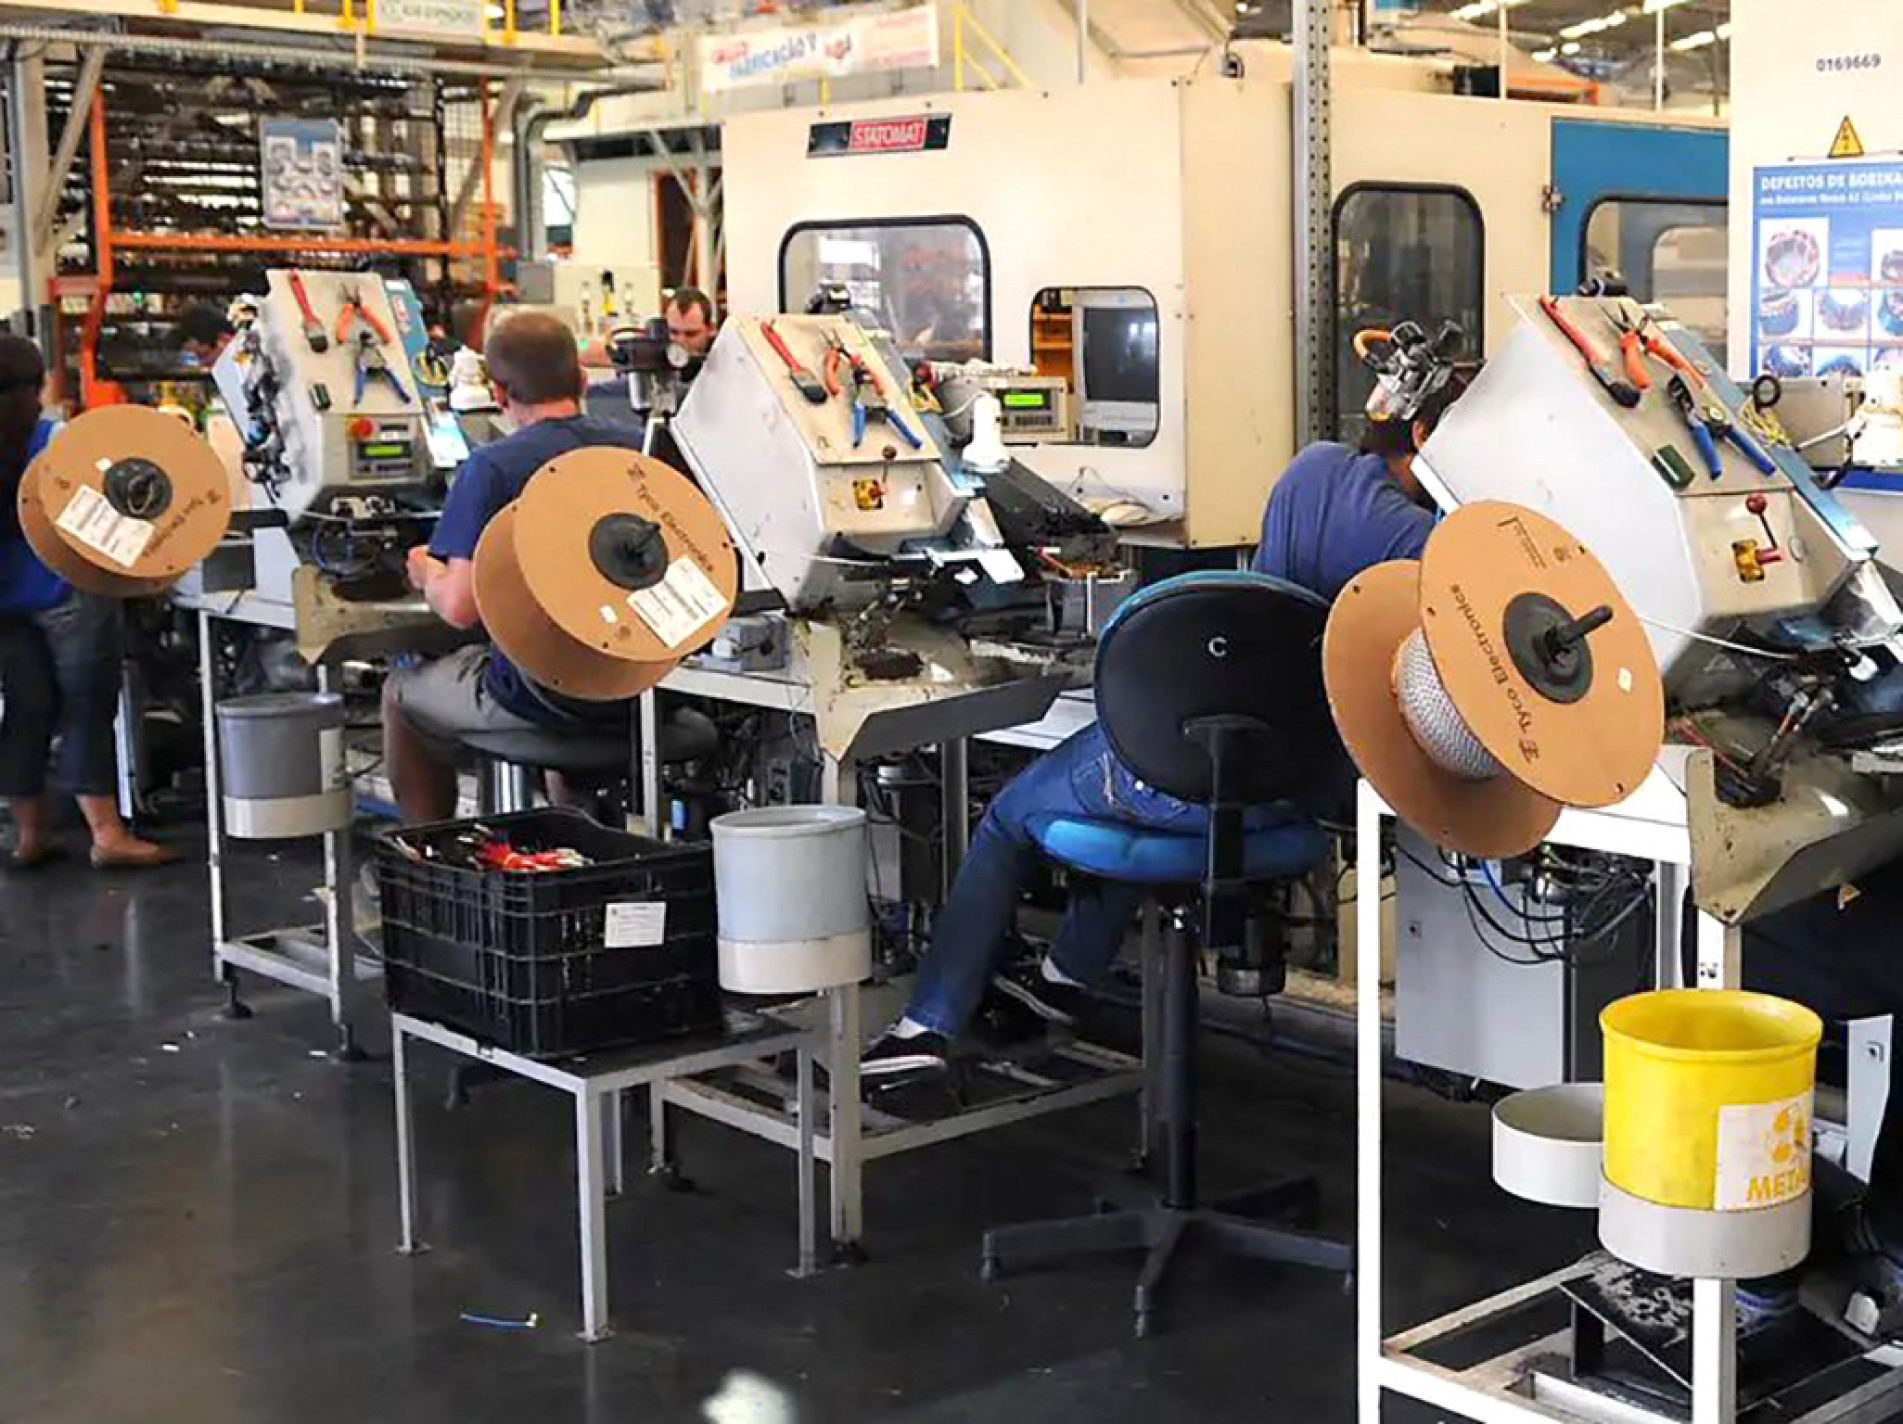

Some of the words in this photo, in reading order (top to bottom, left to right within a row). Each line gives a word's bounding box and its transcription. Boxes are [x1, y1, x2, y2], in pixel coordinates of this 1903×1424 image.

[1816, 53, 1881, 72] 0169669
[854, 122, 924, 147] STATOMAT
[1761, 173, 1824, 190] DEFEITOS
[1827, 172, 1846, 189] DE
[1450, 584, 1509, 685] Electronics
[1507, 687, 1533, 734] Tyco
